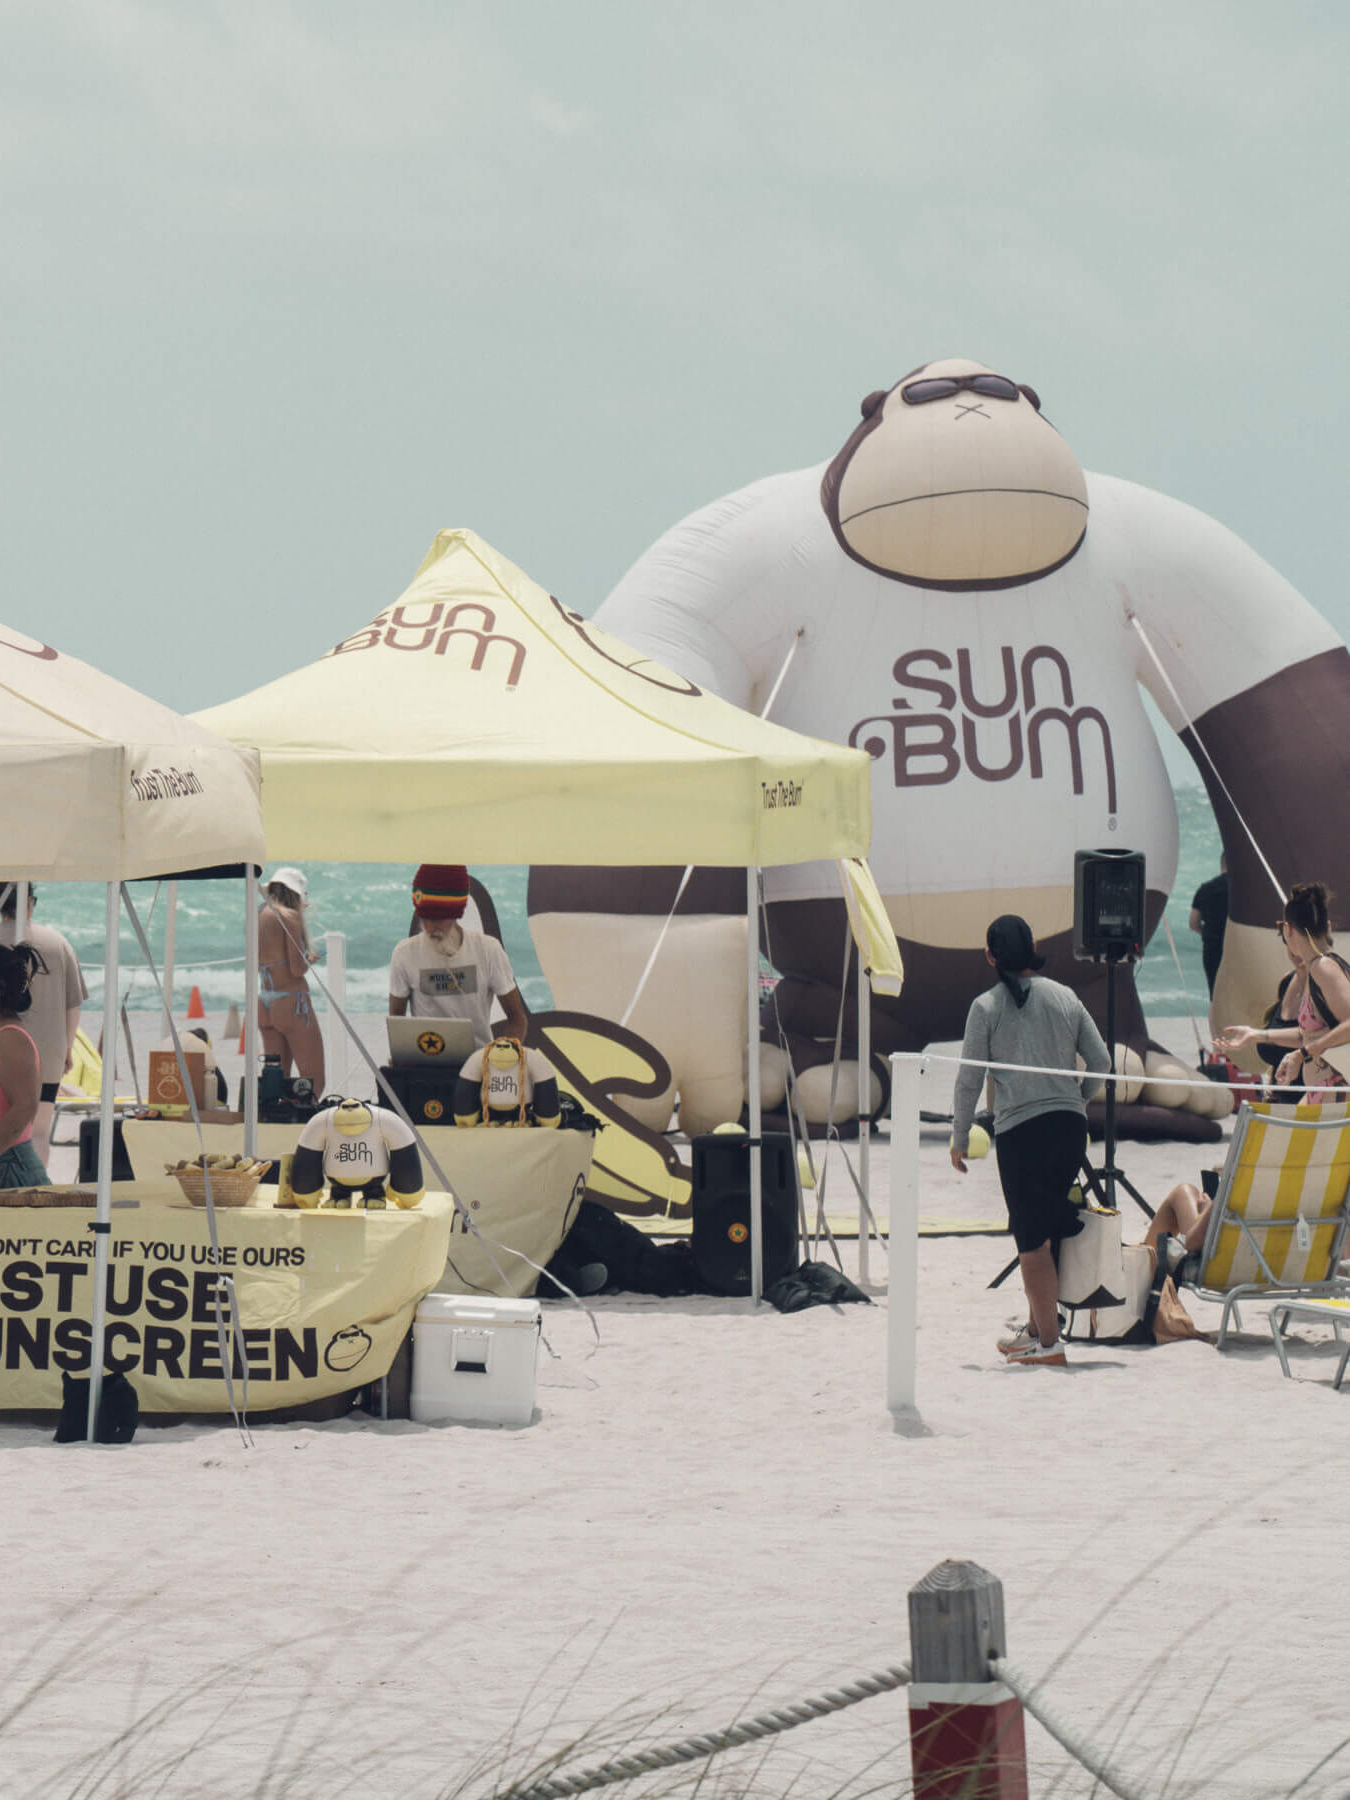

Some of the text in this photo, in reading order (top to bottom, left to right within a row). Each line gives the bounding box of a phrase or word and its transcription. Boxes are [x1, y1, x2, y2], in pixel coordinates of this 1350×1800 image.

[130, 769, 163, 801] Trust
[151, 767, 182, 799] The
[761, 781, 778, 809] Trust
[777, 780, 789, 809] The
[46, 1239, 98, 1258] CAR
[112, 1240, 134, 1259] IF
[138, 1241, 186, 1261] YOU
[190, 1245, 238, 1266] USE
[242, 1246, 306, 1267] OURS
[105, 1263, 234, 1324] USE
